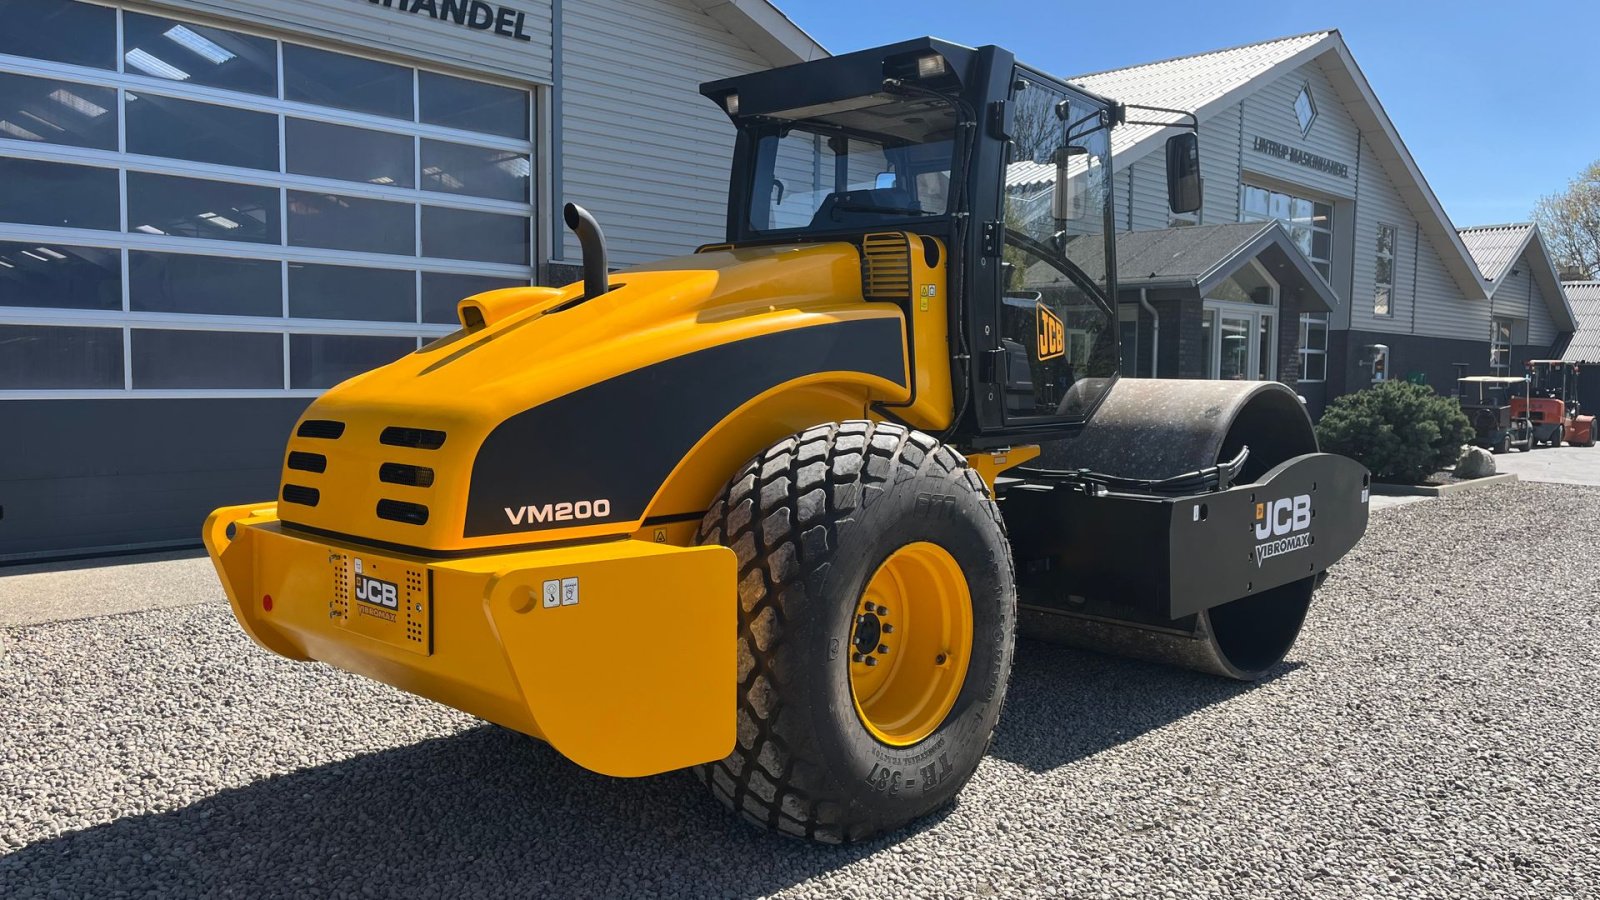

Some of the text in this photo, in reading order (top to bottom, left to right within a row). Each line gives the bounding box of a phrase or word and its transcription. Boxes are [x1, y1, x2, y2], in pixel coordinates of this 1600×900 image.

[368, 0, 531, 42] ANDEL
[1040, 311, 1063, 355] JCB
[504, 499, 611, 526] VM200
[1255, 494, 1311, 540] JCB
[1255, 532, 1310, 568] VIBROMAX
[356, 578, 398, 608] JCB
[357, 603, 397, 624] VIBROMAX
